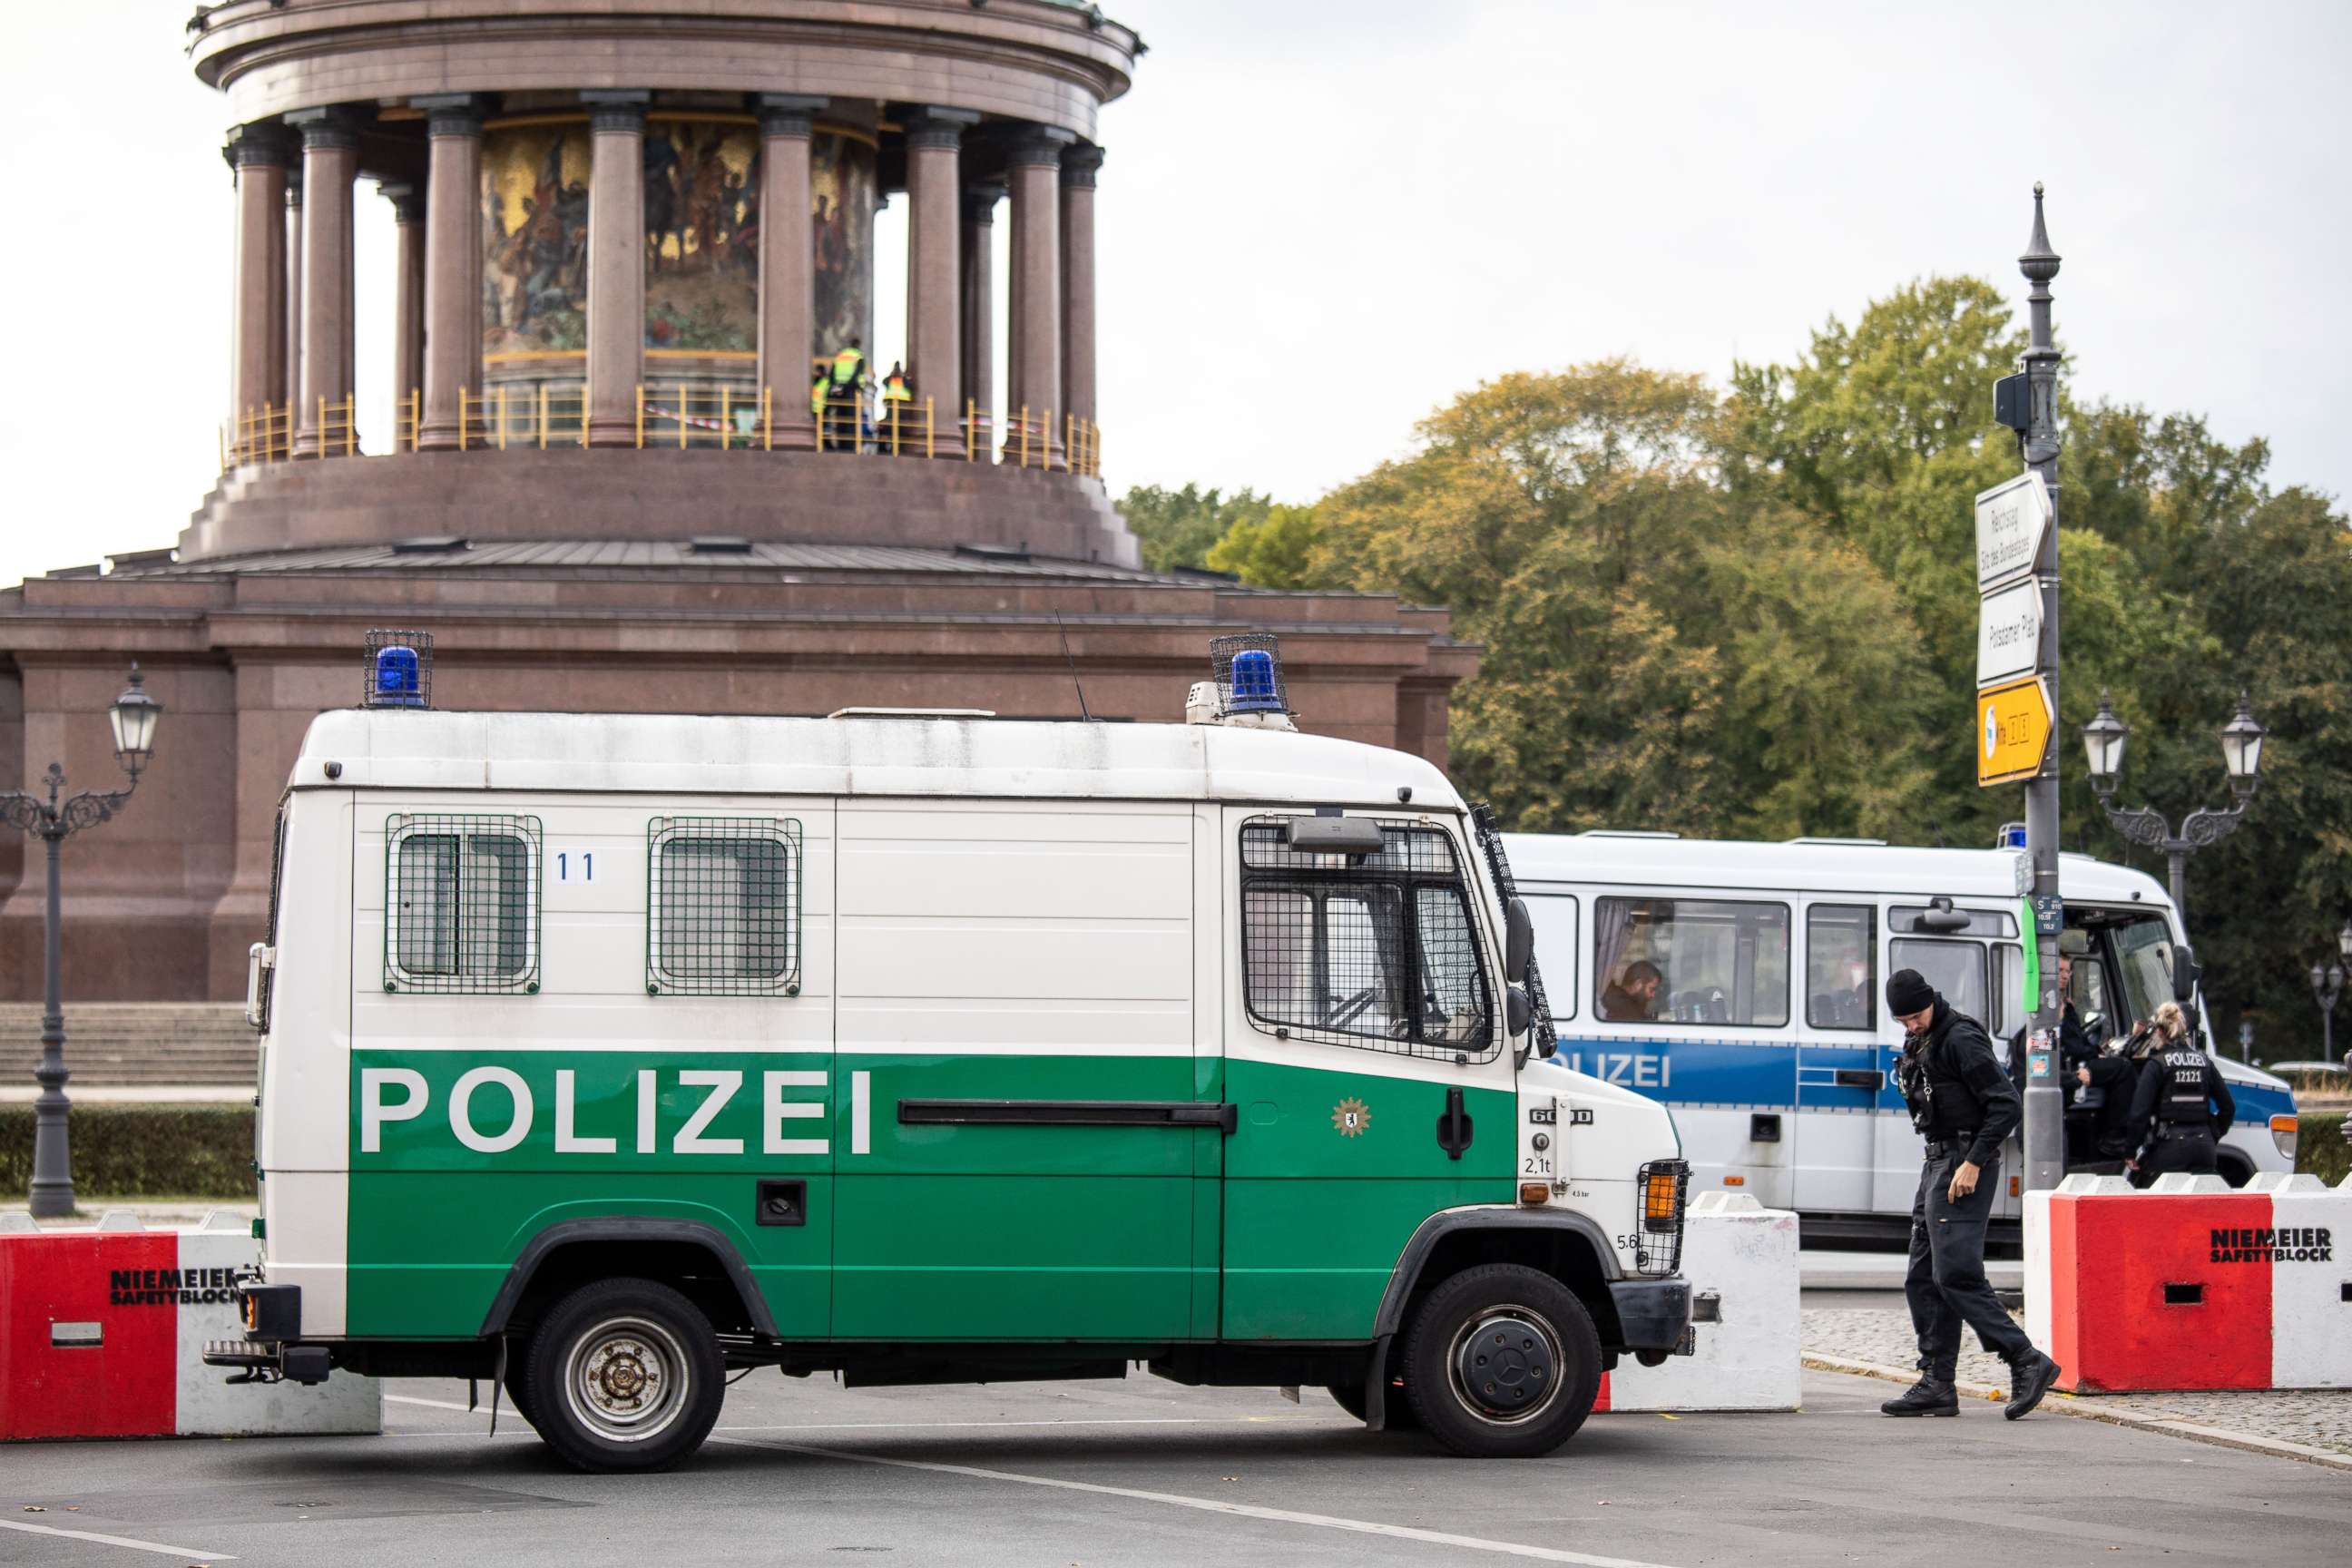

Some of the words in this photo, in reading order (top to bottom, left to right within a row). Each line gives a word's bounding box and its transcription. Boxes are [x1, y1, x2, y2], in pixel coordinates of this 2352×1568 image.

[2164, 1053, 2206, 1067] POLIZEI
[2175, 1071, 2201, 1083] 12121
[360, 1065, 870, 1154] POLIZEI
[2210, 1228, 2332, 1248] NIEMEIER
[2210, 1248, 2332, 1262] SAFETYBLOCK
